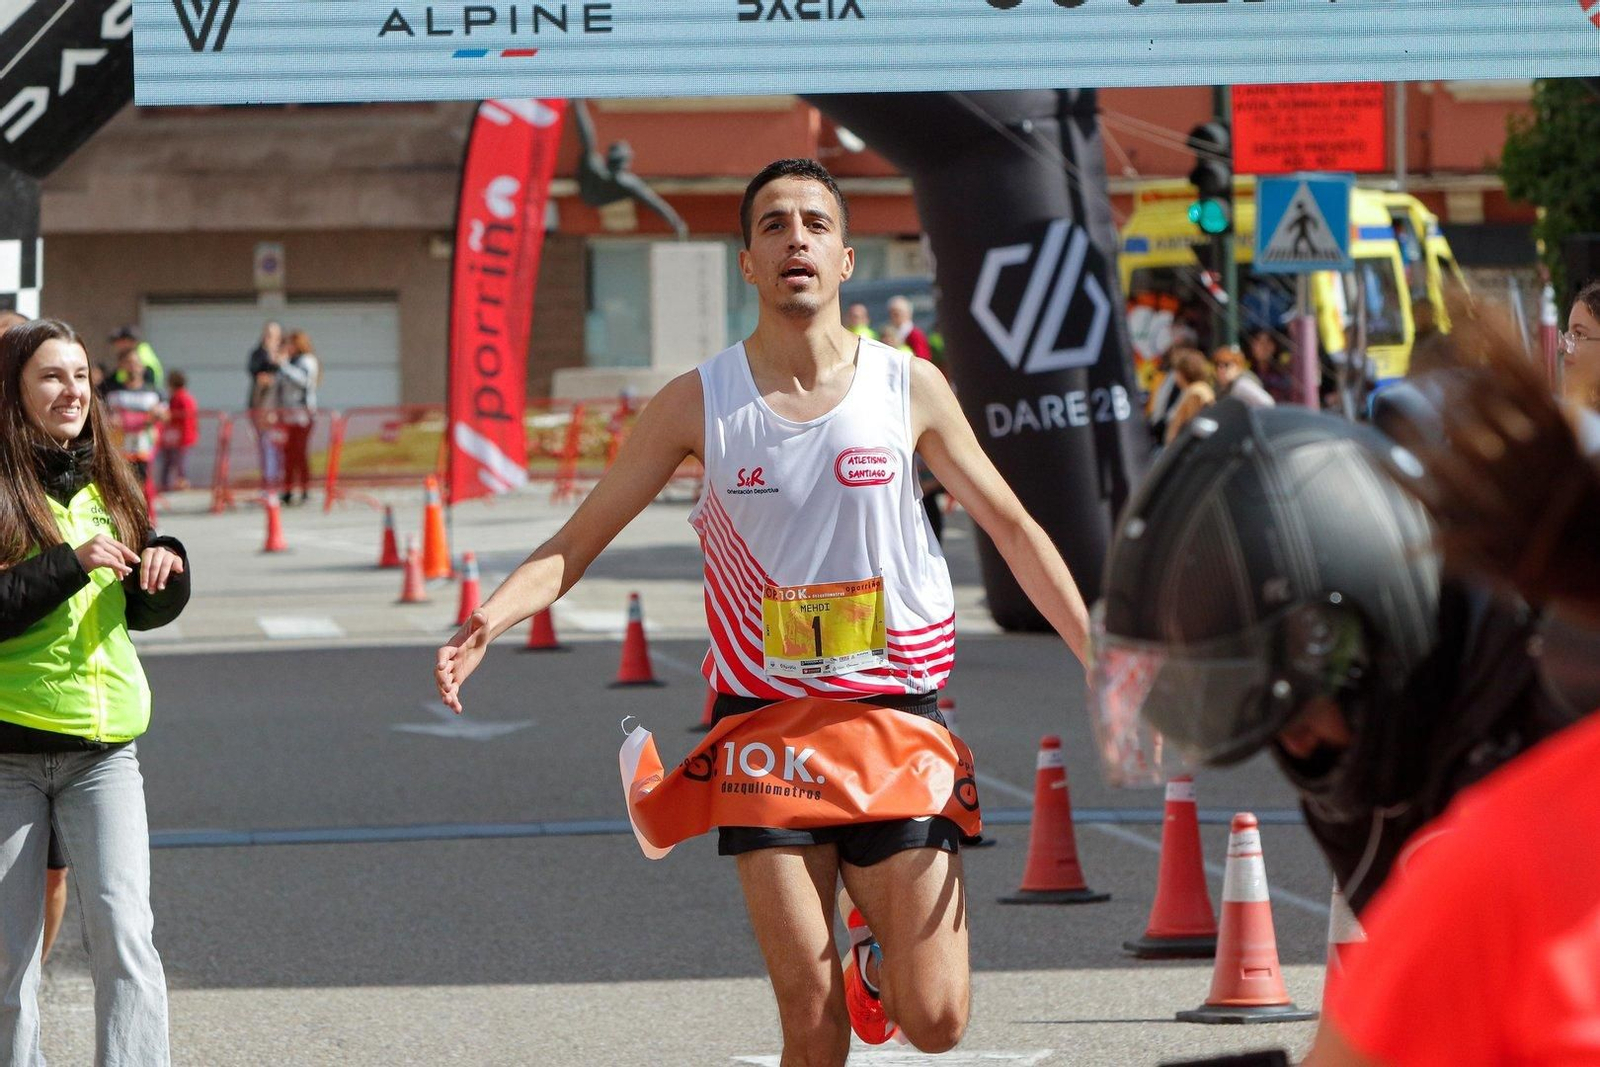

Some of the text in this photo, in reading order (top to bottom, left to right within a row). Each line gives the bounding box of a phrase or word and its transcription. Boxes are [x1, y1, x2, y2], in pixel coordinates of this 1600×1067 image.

[378, 3, 614, 37] ALPINE
[985, 382, 1131, 438] DARE 2B
[847, 455, 888, 465] ATLETISMO
[737, 466, 765, 488] S&R
[847, 469, 886, 479] SANTIAGO
[845, 580, 881, 594] oporriño
[800, 602, 831, 613] MEHDI
[811, 615, 822, 657] 1
[721, 780, 822, 801] dezquilómetros
